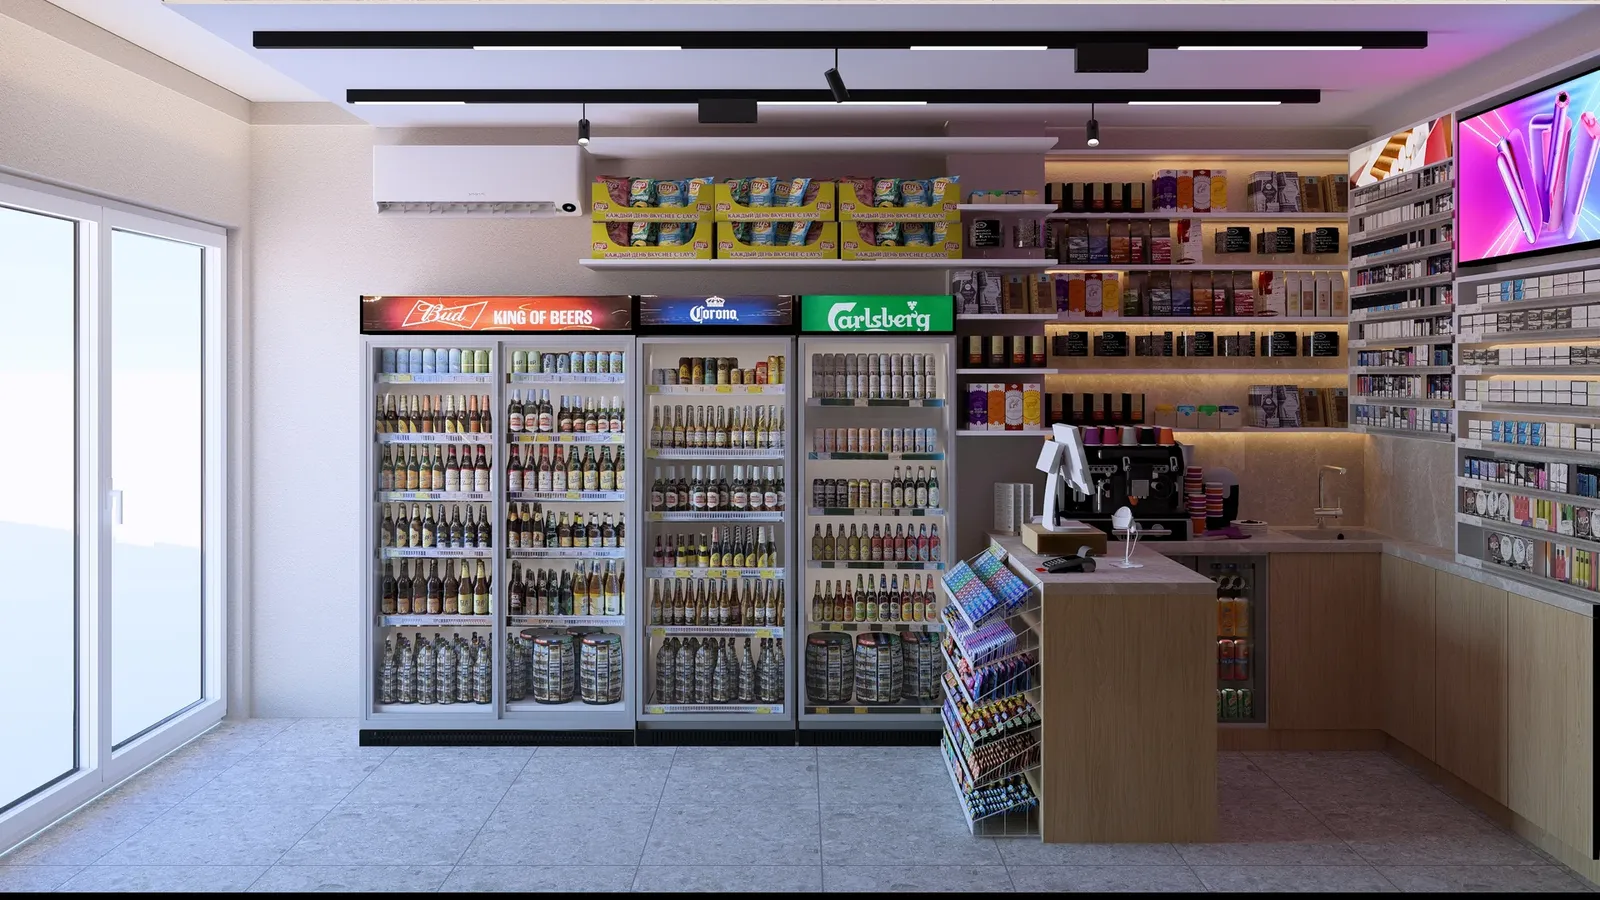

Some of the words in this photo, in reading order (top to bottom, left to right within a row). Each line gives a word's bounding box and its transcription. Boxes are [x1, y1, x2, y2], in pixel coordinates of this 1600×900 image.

[418, 303, 466, 322] Bud
[494, 310, 526, 325] KING
[530, 310, 547, 325] OF
[550, 309, 593, 325] BEERS
[690, 305, 739, 324] Corona
[828, 302, 931, 331] Carlsberg
